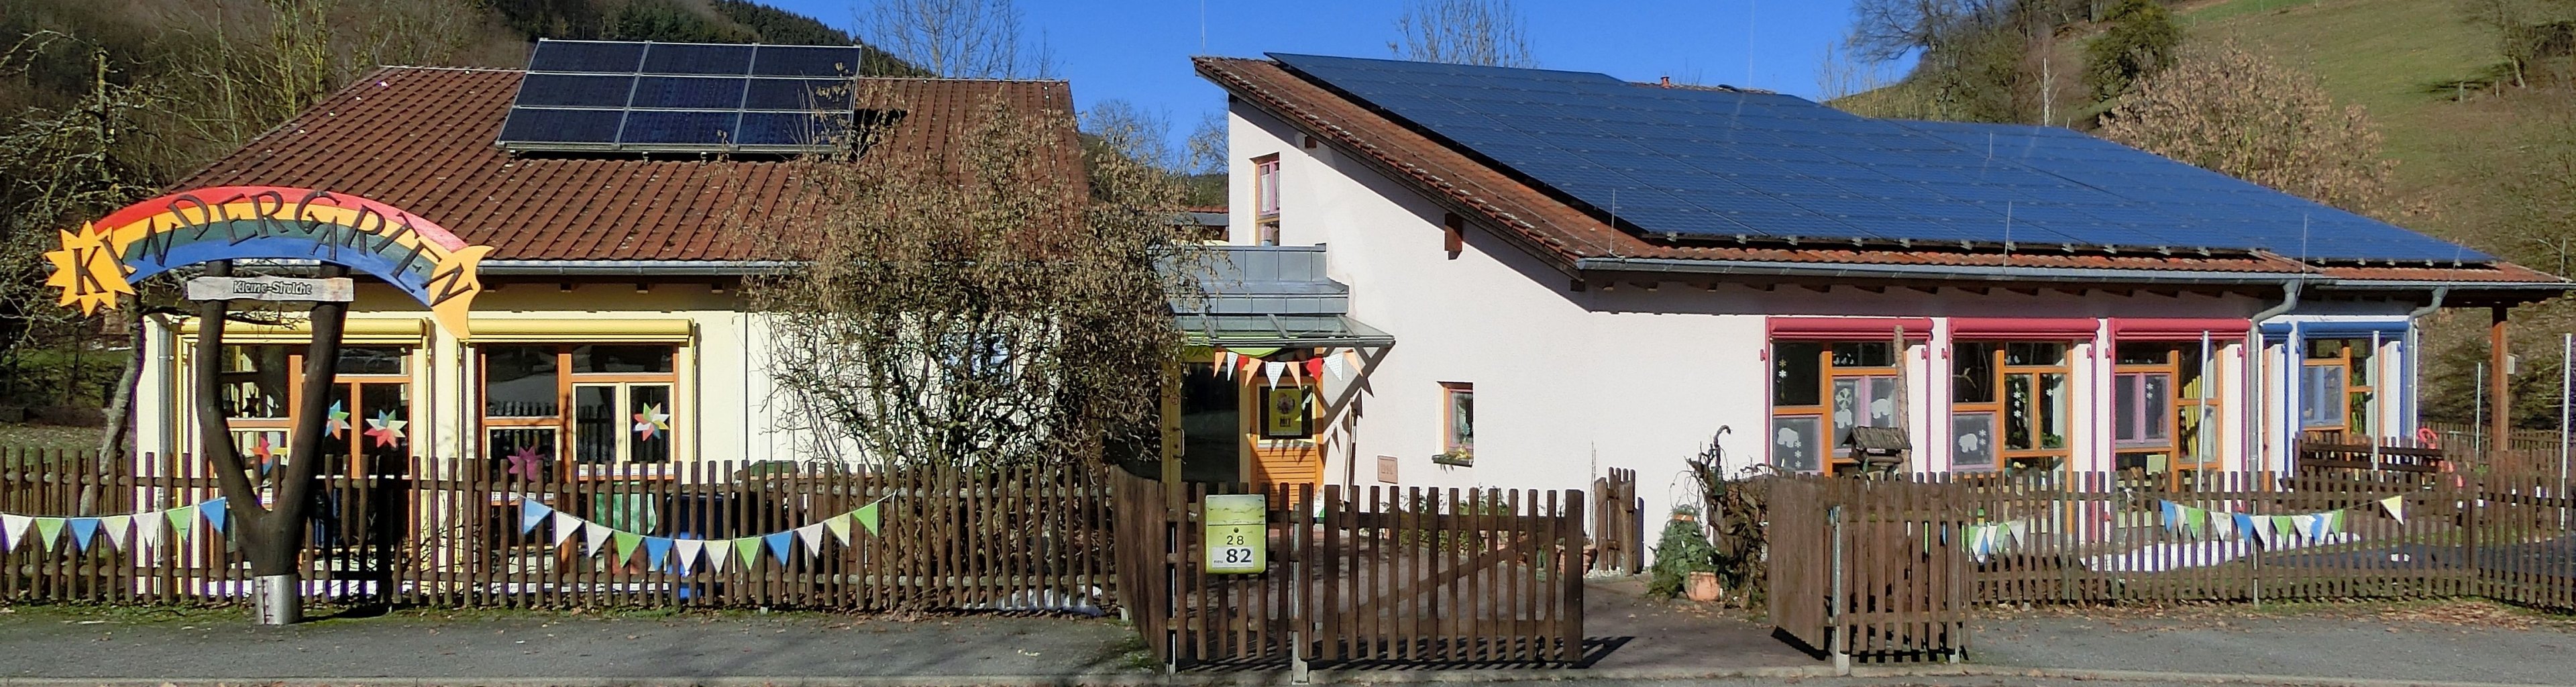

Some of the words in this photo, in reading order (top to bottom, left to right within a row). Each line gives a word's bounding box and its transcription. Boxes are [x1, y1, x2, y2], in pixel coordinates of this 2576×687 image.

[72, 190, 474, 307] KINDERGARTEN
[1226, 535, 1244, 545] 28
[1226, 548, 1252, 563] 82
